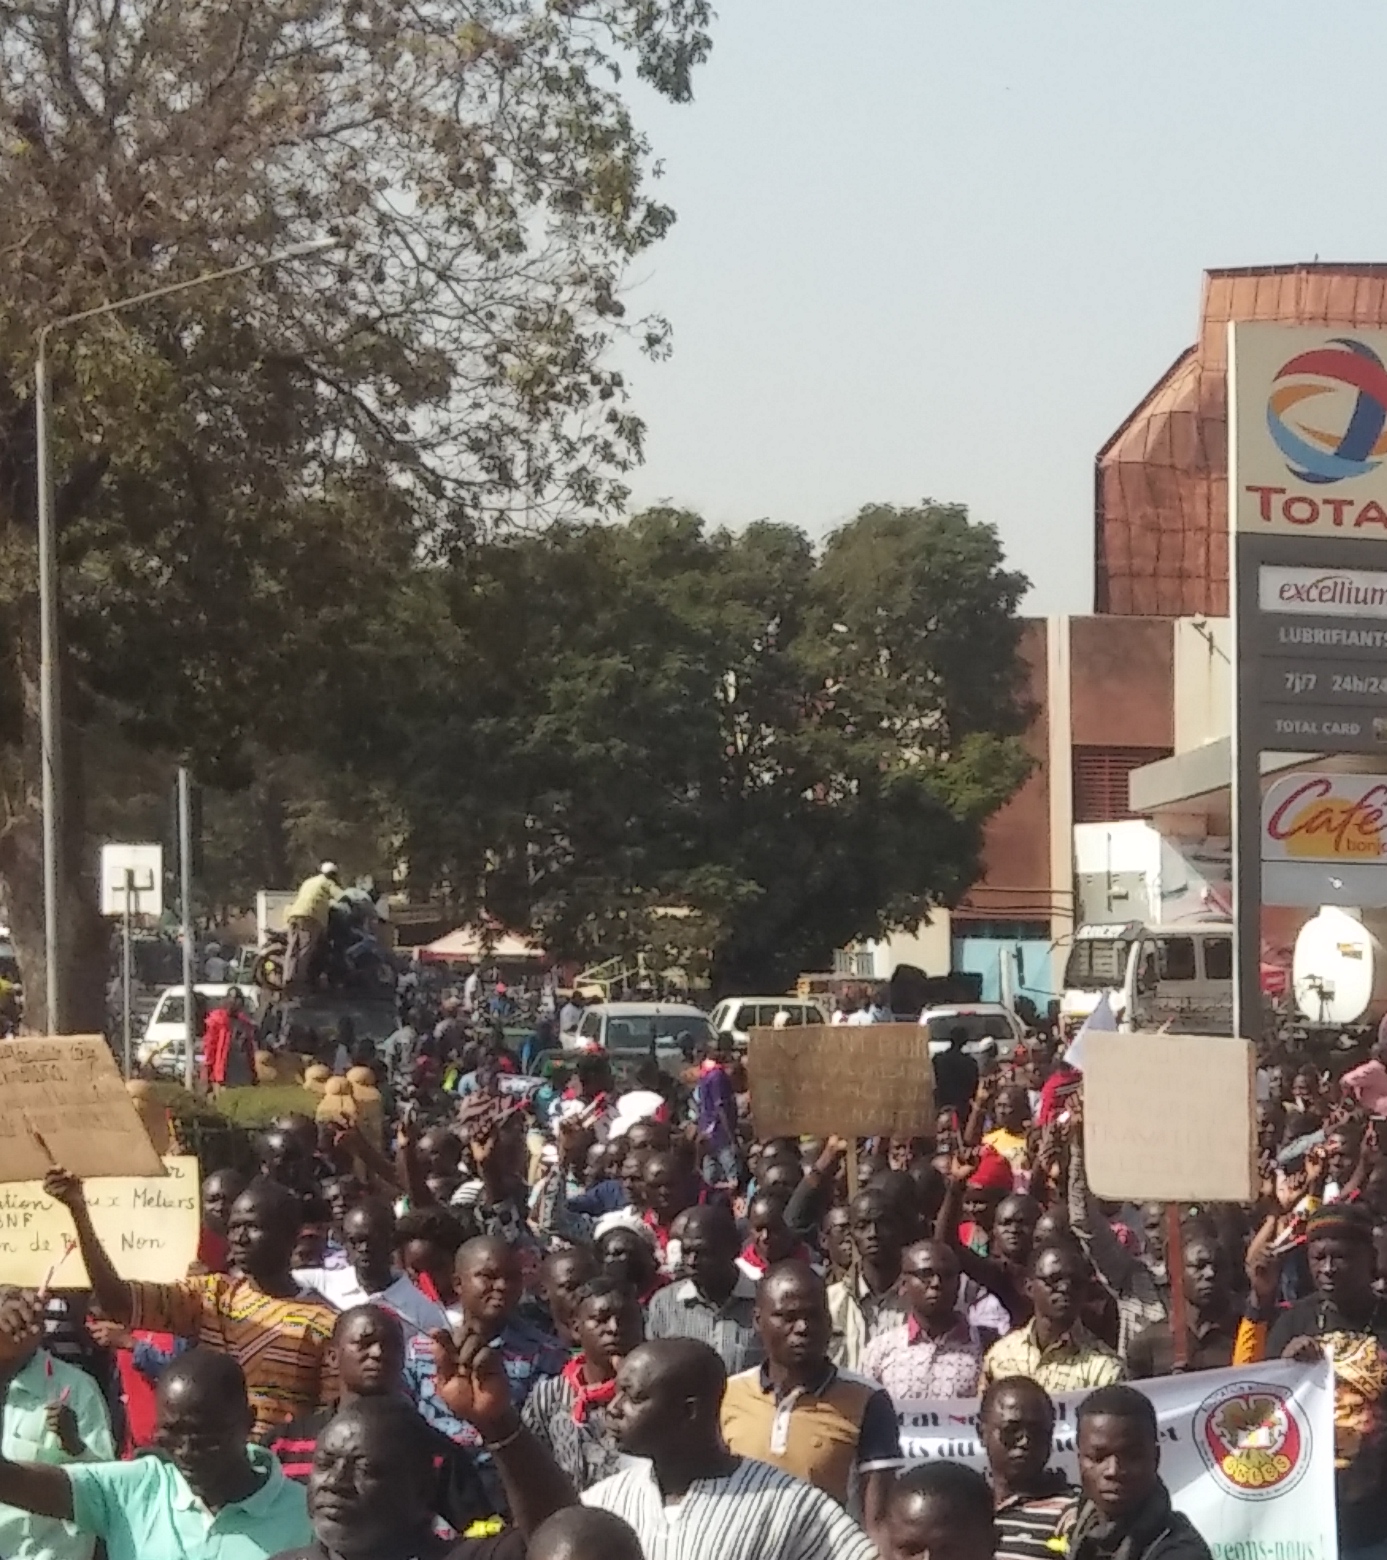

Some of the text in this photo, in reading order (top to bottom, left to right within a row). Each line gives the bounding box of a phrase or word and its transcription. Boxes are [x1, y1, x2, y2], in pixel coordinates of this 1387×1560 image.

[1284, 673, 1317, 694] 7j/7
[1275, 719, 1361, 736] TOTAL CARD
[121, 1230, 166, 1252] Non
